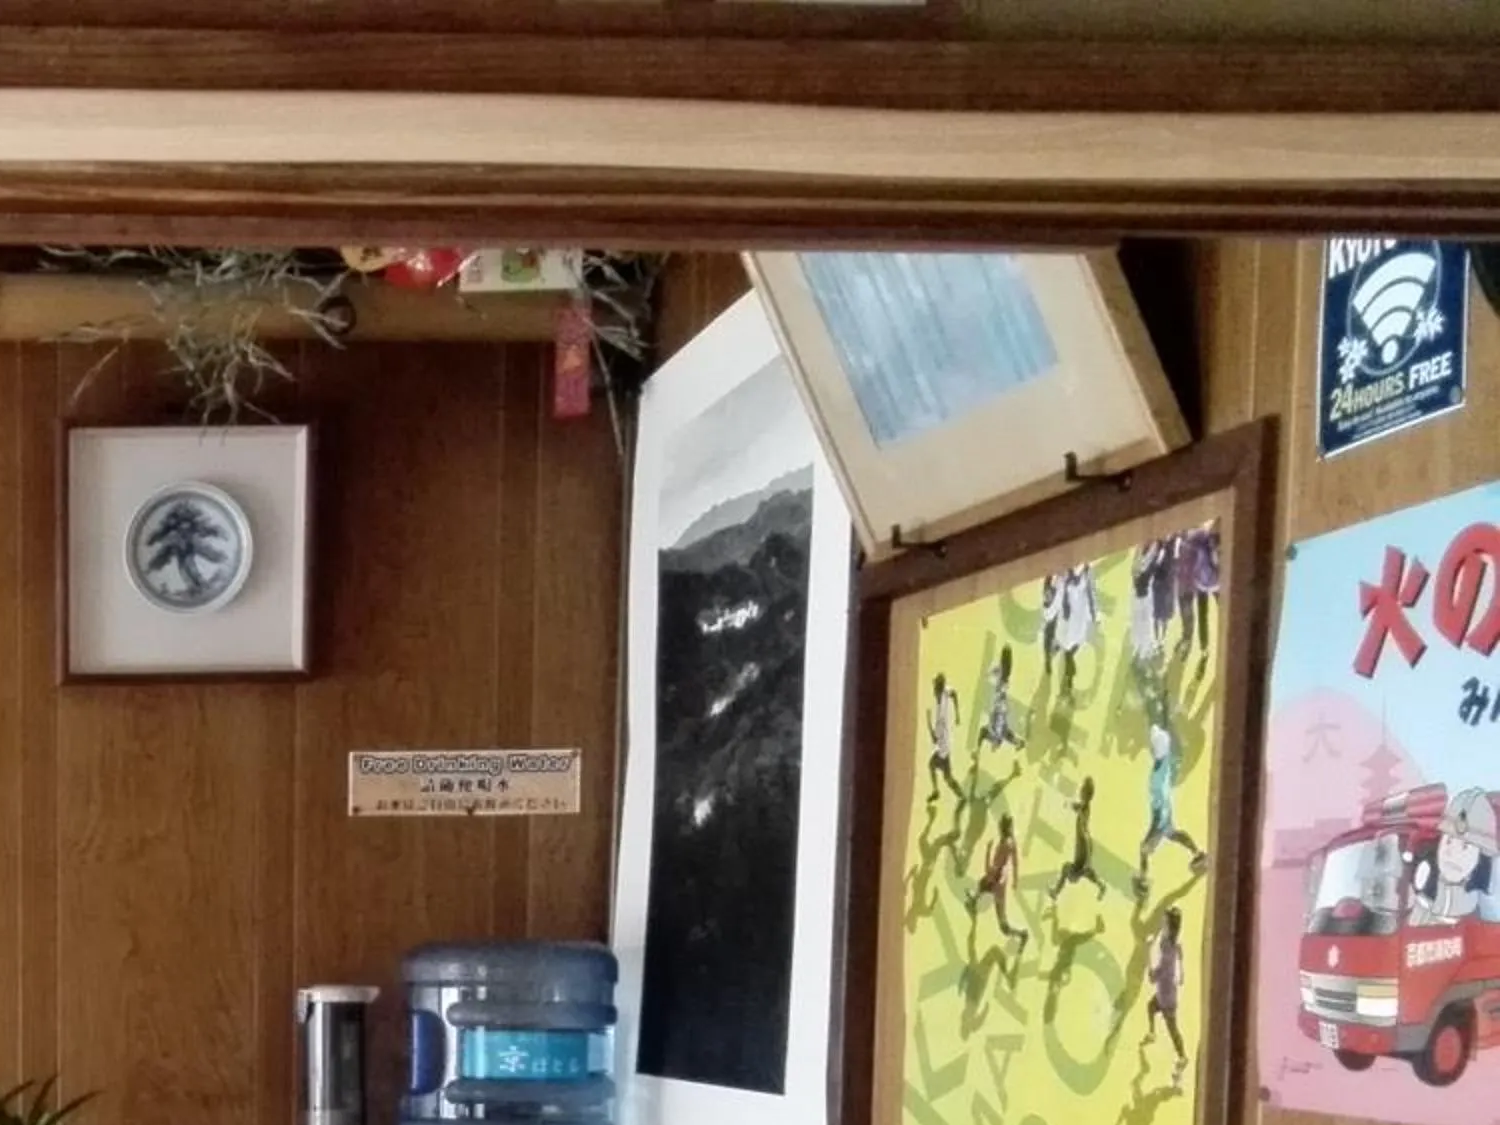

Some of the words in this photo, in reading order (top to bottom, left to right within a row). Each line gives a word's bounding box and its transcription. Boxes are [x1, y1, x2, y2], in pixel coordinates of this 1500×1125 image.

[1409, 351, 1453, 389] FREE
[360, 755, 410, 774] Free
[412, 755, 503, 776] Drinking
[507, 755, 573, 773] Water
